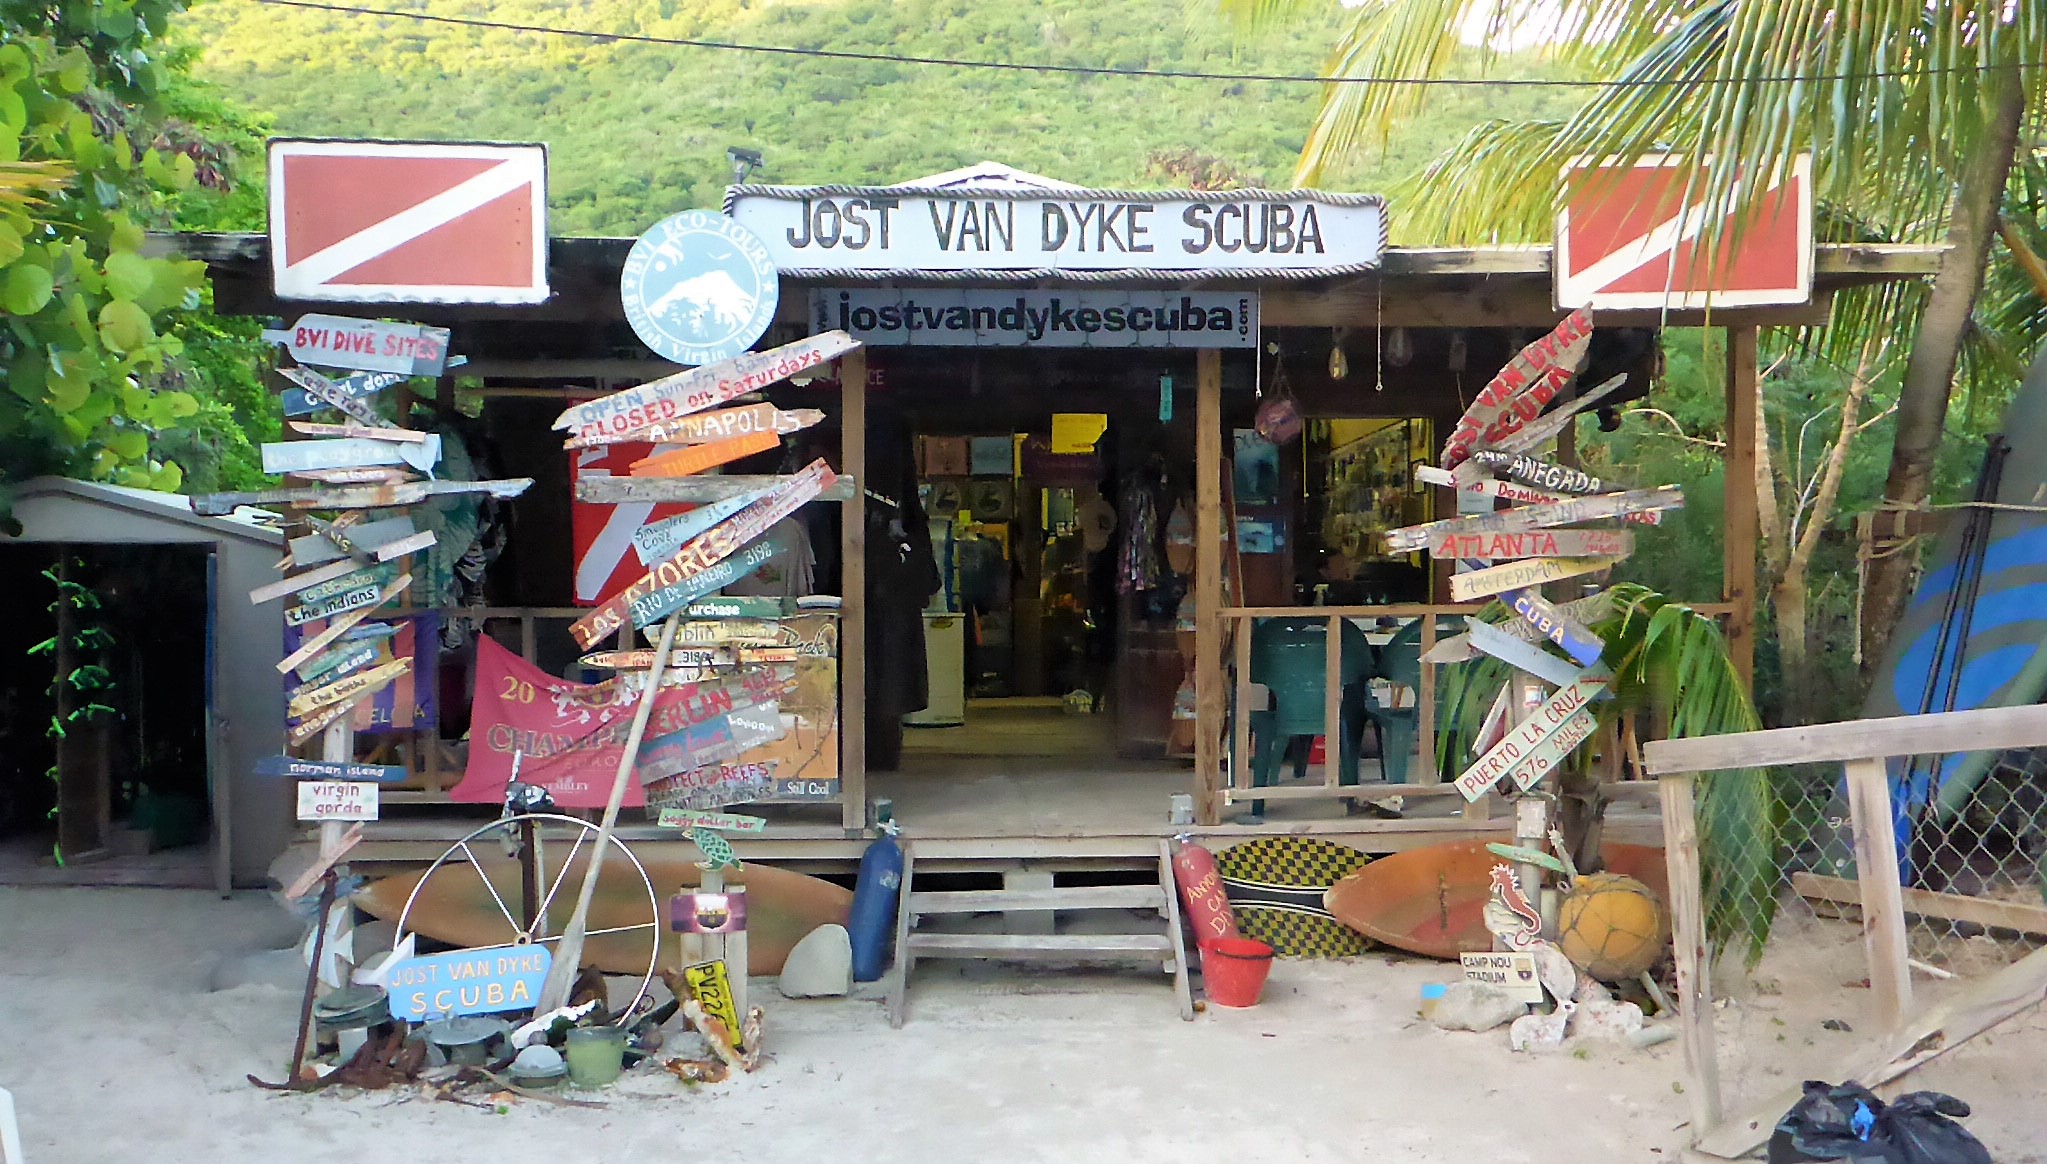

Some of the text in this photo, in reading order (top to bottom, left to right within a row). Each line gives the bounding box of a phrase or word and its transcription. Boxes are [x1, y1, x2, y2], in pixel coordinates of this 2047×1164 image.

[627, 212, 773, 275] BVI ECO-TOURS
[786, 199, 1325, 254] JOST VAN DYKE SCUBA
[295, 328, 440, 361] BVI DIVE SITES
[672, 342, 727, 364] Virgin
[1478, 364, 1525, 407] VAN
[1523, 309, 1593, 371] DYKE
[719, 349, 823, 400] Saturdays
[1484, 366, 1575, 443] SCUBA
[650, 407, 800, 442] ANNAPOLIS
[1507, 455, 1600, 493] ANEGADA
[1437, 532, 1559, 557] ATLANTA
[1462, 560, 1561, 592] AMSTERDAM
[633, 594, 661, 623] RIO
[684, 603, 740, 616] urchase
[1514, 597, 1564, 644] CUBA
[1463, 683, 1585, 794] PUERTO LA CRUZ
[1515, 713, 1590, 785] 576 MILES
[313, 783, 360, 800] virgin
[787, 781, 805, 794] Still
[808, 781, 829, 794] Cool
[315, 800, 362, 814] gorda
[392, 953, 544, 987] JOST VAN DYKE
[1463, 956, 1512, 968] CAMP NOU
[1465, 971, 1507, 984] STADIUM
[411, 980, 529, 1014] SCUBA
